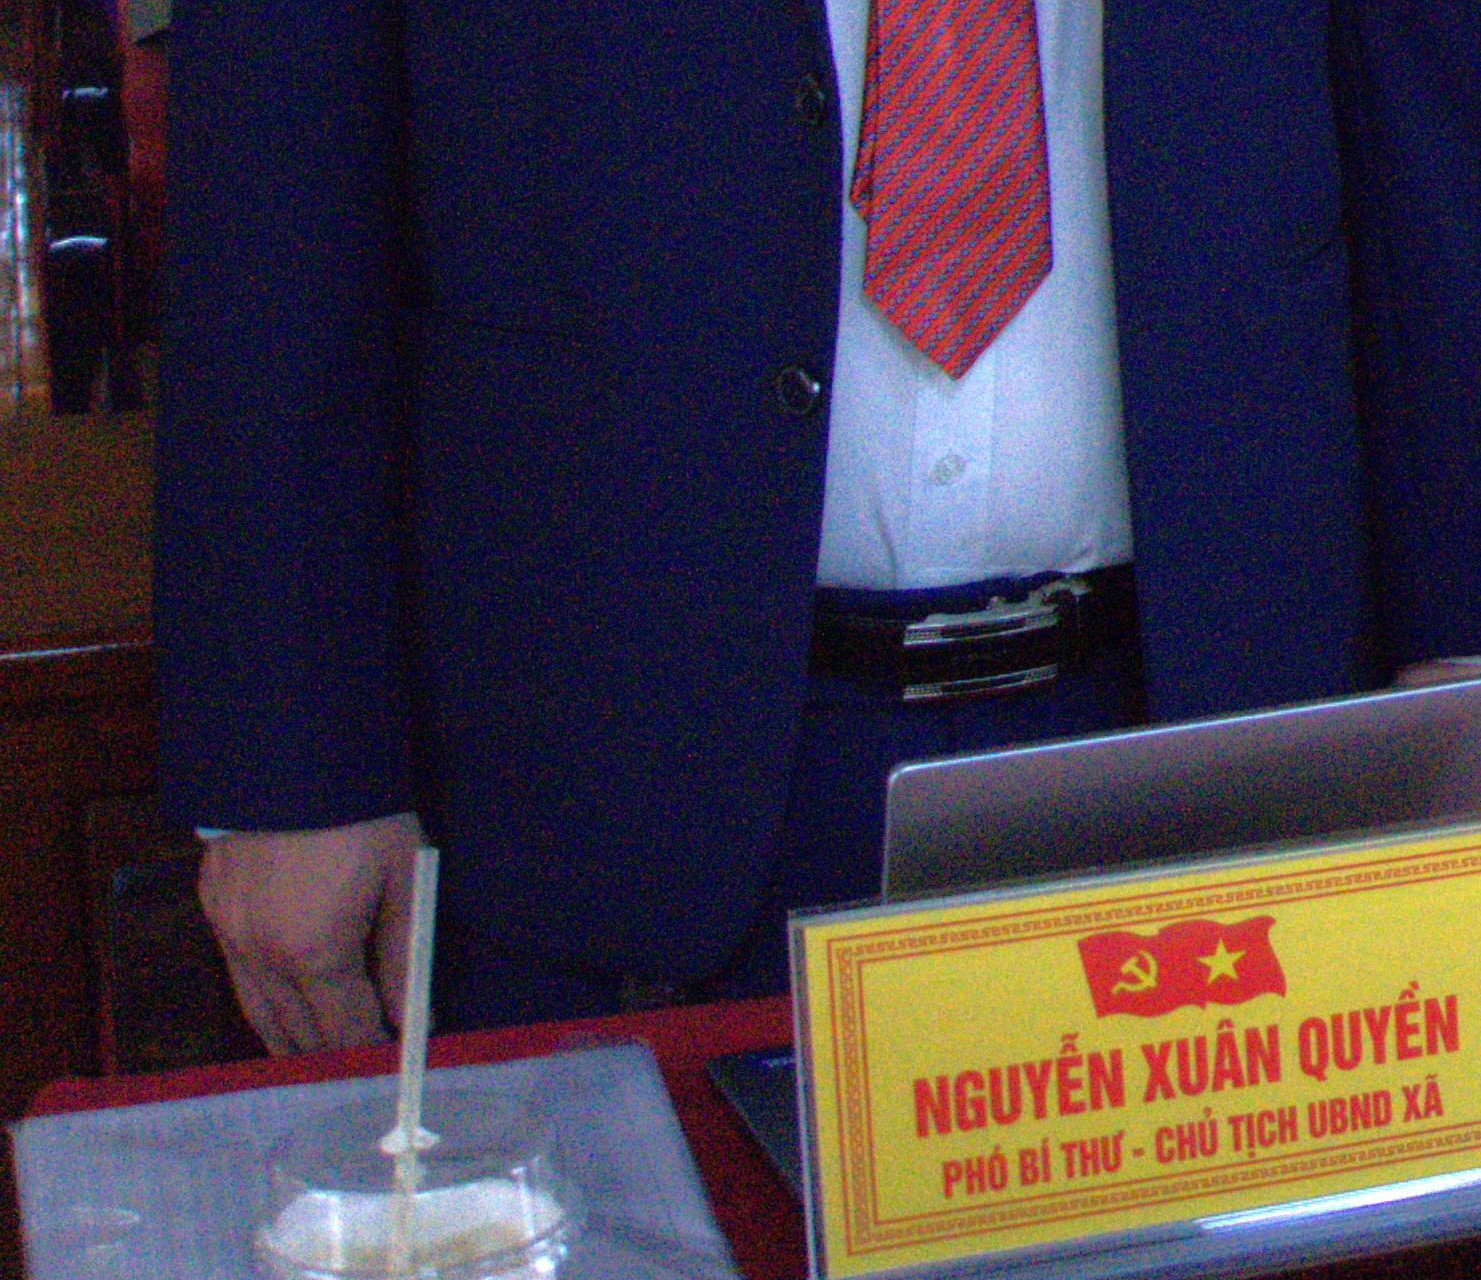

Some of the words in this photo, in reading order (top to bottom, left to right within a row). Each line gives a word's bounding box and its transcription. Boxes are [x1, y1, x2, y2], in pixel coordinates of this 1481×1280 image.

[912, 1033, 1128, 1139] NGUYỄN
[1141, 1018, 1282, 1104] XUÂN
[1298, 980, 1460, 1081] QUYỀN
[942, 1144, 1010, 1199] PHÓ
[1019, 1140, 1053, 1187] BÍ
[1060, 1125, 1125, 1180] THƯ
[1132, 1150, 1146, 1159] -
[1155, 1106, 1220, 1165] CHỦ
[1227, 1103, 1299, 1159] TỊCH
[1308, 1083, 1394, 1132] UBND
[1401, 1073, 1445, 1124] XÃ
